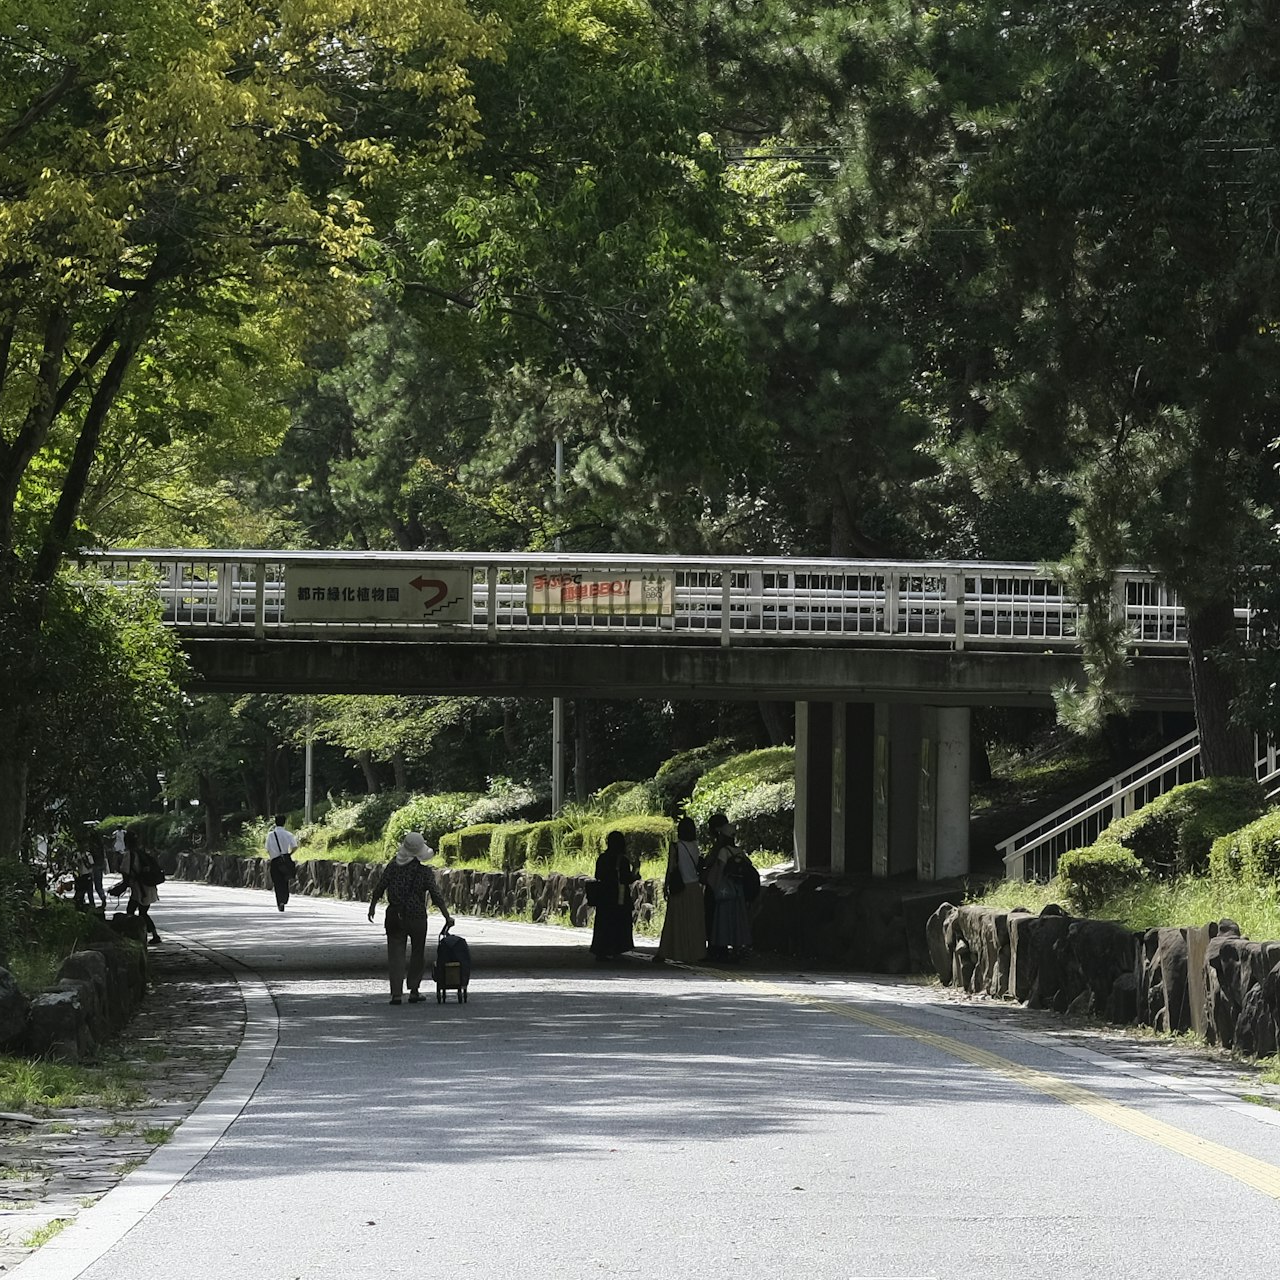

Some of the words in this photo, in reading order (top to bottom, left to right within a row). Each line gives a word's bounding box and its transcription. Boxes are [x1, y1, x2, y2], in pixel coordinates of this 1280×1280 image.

[297, 586, 400, 602] 都市緑化植物園
